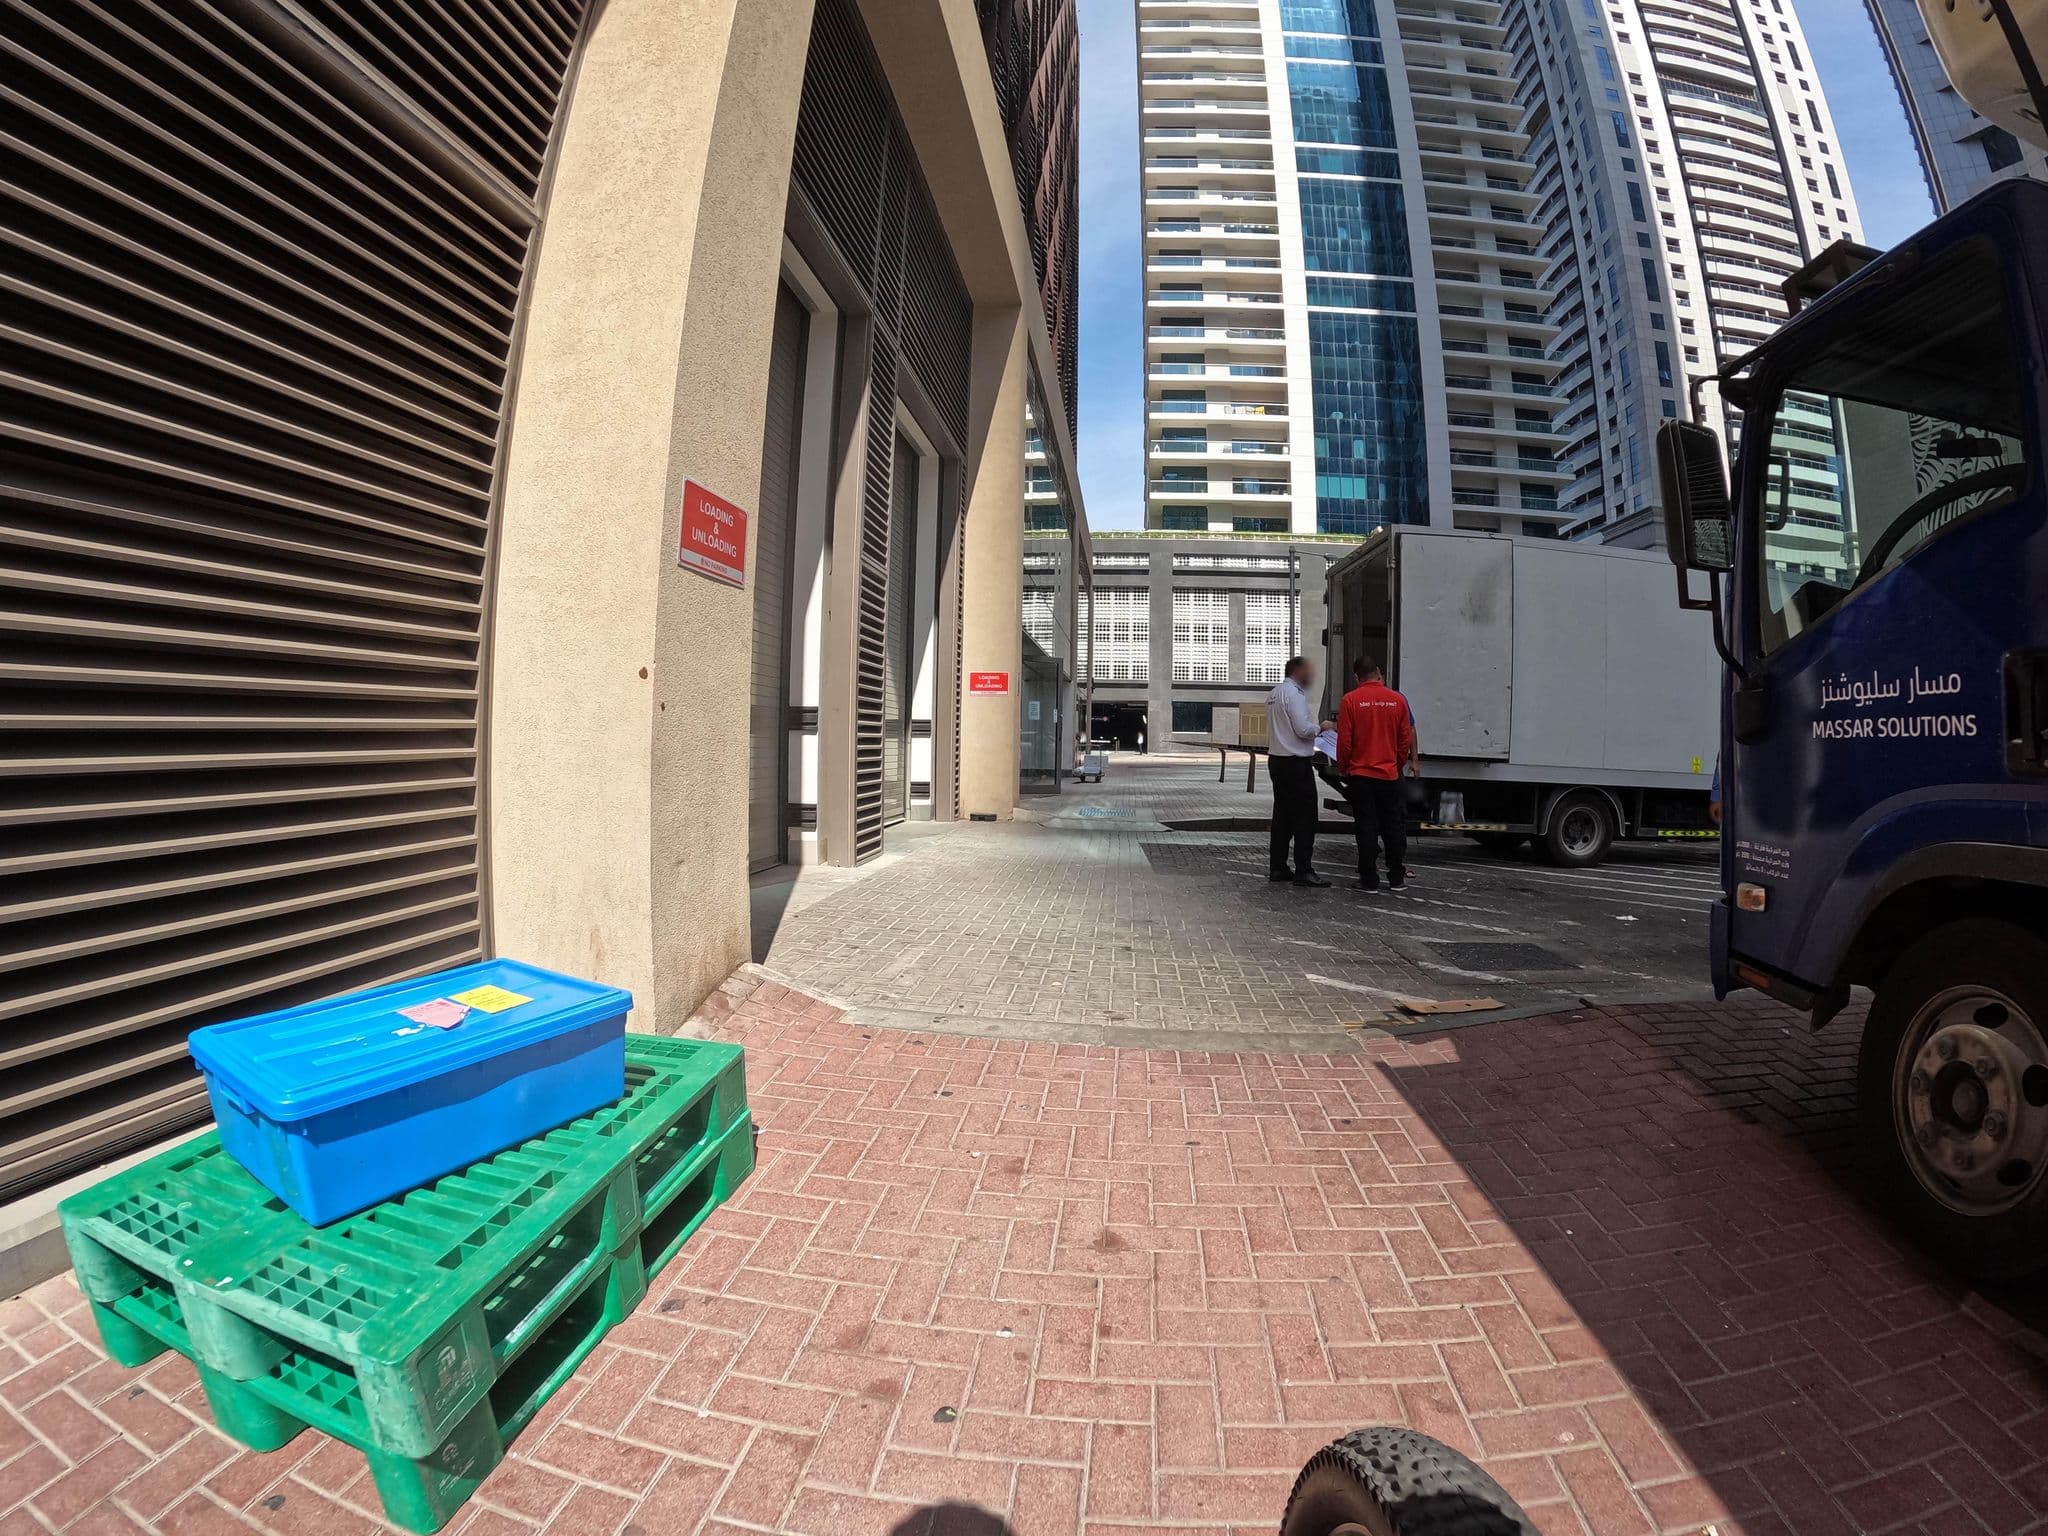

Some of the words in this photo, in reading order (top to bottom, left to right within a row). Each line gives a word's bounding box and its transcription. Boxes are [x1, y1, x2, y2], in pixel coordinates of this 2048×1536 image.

[699, 499, 734, 527] LOADING
[691, 526, 737, 558] UNLOADING
[713, 522, 721, 535] &
[1820, 671, 1900, 709] سليوشنز
[1907, 666, 1962, 704] مسار
[1812, 717, 1874, 739] MASSAR
[1877, 714, 1978, 738] SOLUTIONS
